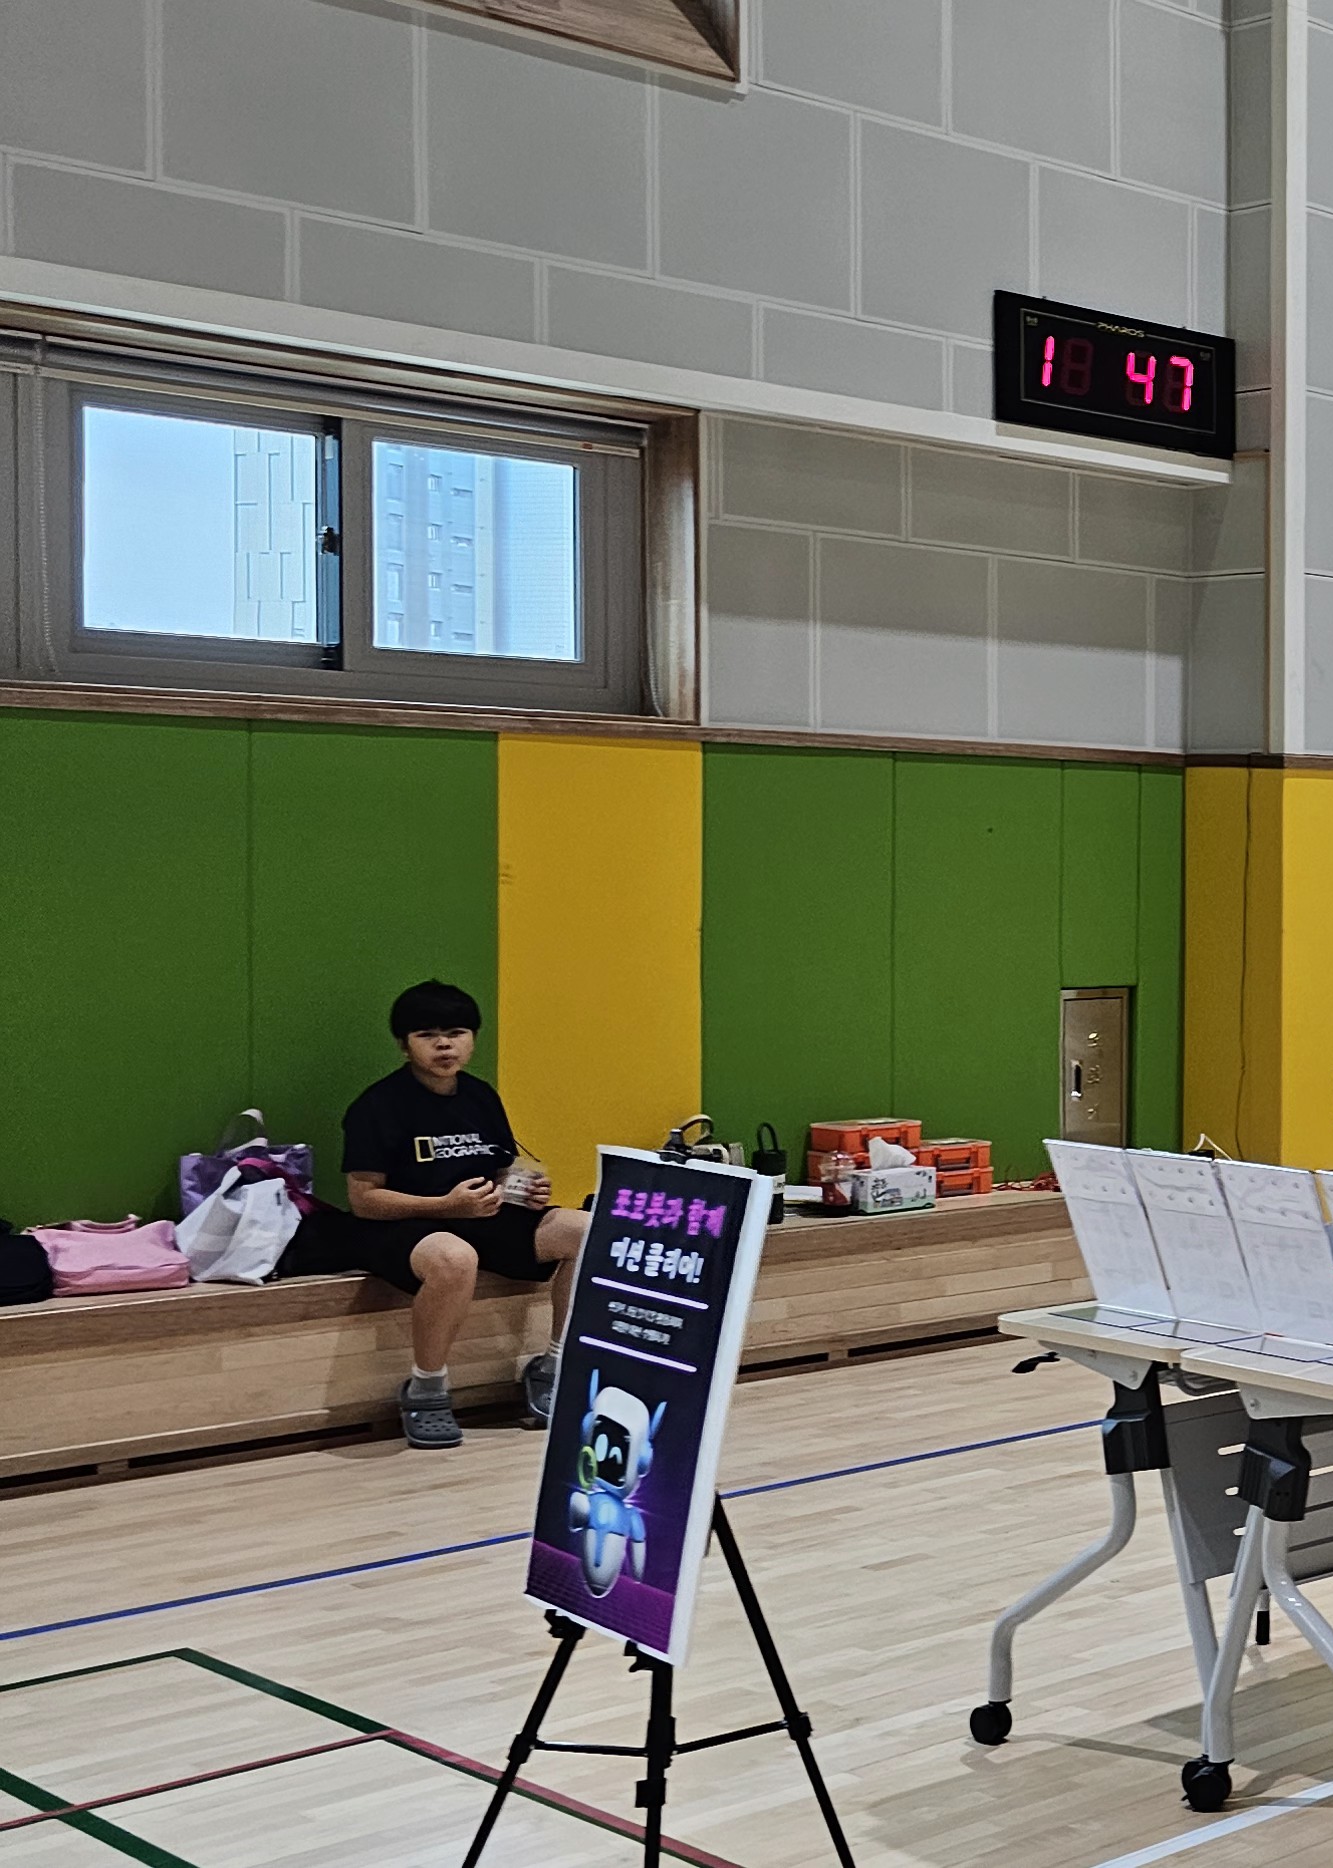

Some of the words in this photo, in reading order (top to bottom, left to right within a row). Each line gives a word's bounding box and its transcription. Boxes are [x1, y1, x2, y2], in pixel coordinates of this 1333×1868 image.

[1041, 335, 1055, 387] 1
[1126, 352, 1194, 411] 47
[432, 1133, 483, 1147] NATIONAL
[610, 1236, 646, 1272] 미션
[644, 1242, 705, 1284] 클리어!
